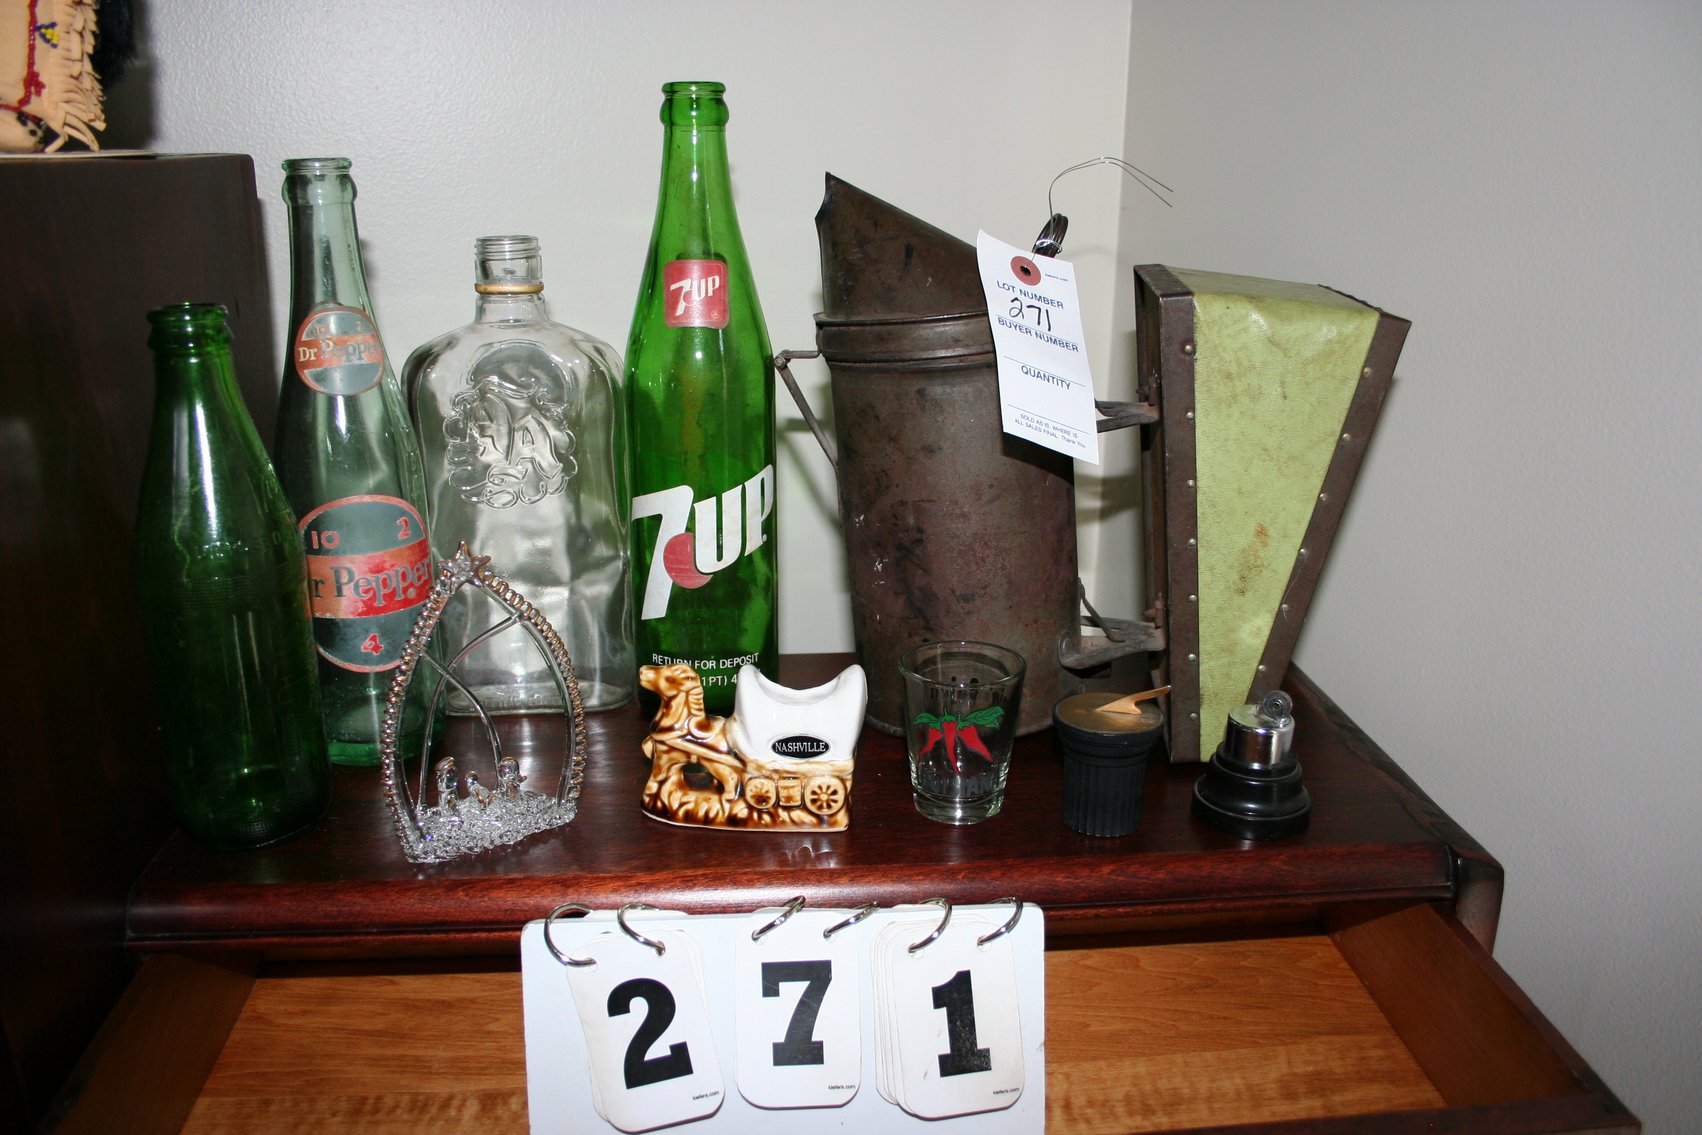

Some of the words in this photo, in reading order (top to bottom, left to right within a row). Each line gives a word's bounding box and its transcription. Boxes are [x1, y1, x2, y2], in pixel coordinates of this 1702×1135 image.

[670, 275, 720, 317] 7UP
[996, 280, 1016, 294] LOT
[1019, 288, 1064, 309] NUMBER
[1008, 296, 1051, 332] 271
[356, 321, 364, 332] 2
[997, 316, 1033, 337] BUYER
[1035, 331, 1079, 353] NUMBER
[298, 346, 317, 362] Dr
[1020, 364, 1071, 391] QUANTITY
[1014, 418, 1024, 426] ALL
[1025, 422, 1042, 433] SALES
[1020, 413, 1035, 423] SOLD
[1036, 419, 1044, 427] AS
[396, 516, 412, 540] 2
[631, 464, 774, 621] 7UP
[329, 556, 431, 607] Pepper
[360, 632, 385, 655] 4
[694, 660, 716, 670] FOR
[719, 652, 760, 669] DEPOSIT
[775, 742, 826, 752] NASHVILLE
